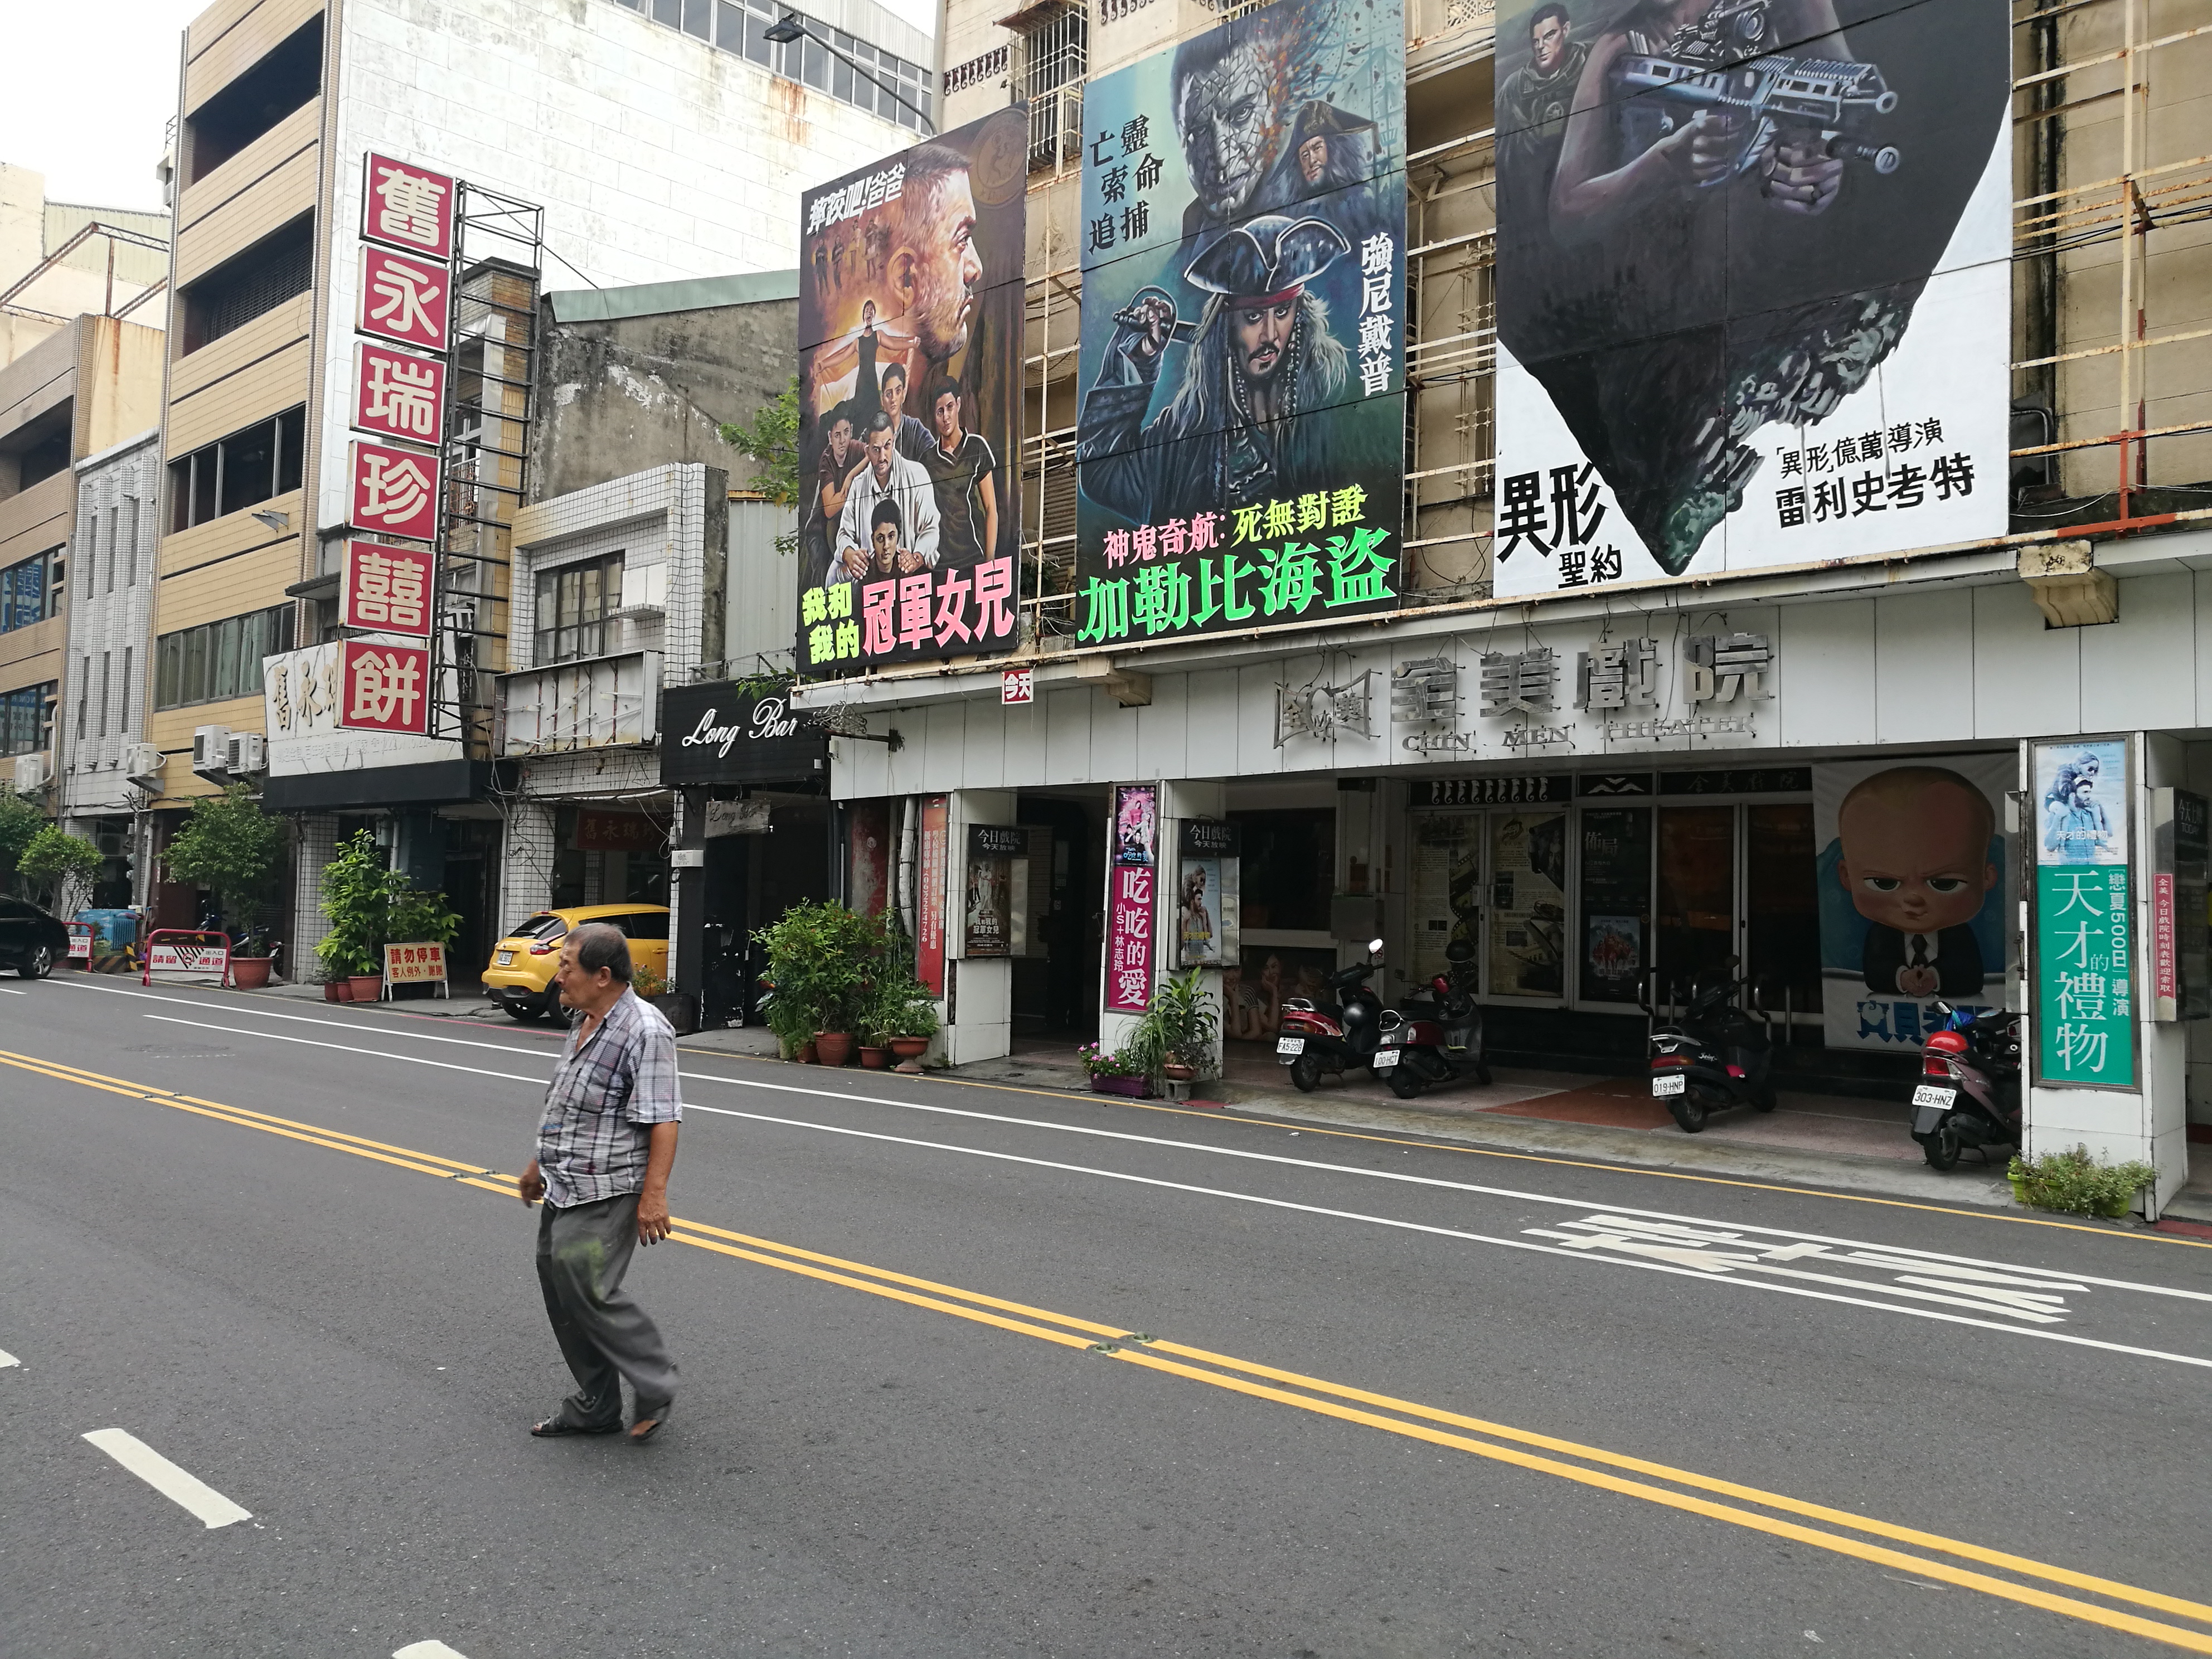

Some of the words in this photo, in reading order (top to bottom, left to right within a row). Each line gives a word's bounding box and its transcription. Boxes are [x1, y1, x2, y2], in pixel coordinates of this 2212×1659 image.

[1089, 114, 1151, 168] 亡靈
[1100, 152, 1165, 206] 索命
[1088, 200, 1149, 254] 追捕
[1358, 231, 1394, 396] 強尼戴普
[350, 167, 445, 726] 舊永瑞珍囍餅
[1230, 483, 1368, 548] 死無對證
[1496, 461, 1609, 564] 異形
[1775, 451, 1975, 530] 雷利史考特
[1077, 526, 1397, 643] 加勒比海盜
[1558, 544, 1622, 589] 聖約
[802, 582, 852, 626] 我和
[862, 555, 1015, 657] 冠軍女兒
[809, 619, 859, 664] 我的
[273, 658, 336, 731] 舊永
[1005, 675, 1030, 700] 今天
[1391, 632, 1768, 723] 全美戲院
[682, 708, 740, 758] Long
[749, 697, 798, 739] Bar
[1503, 725, 1572, 746] MEN
[1595, 715, 1758, 740] THEATER
[1687, 770, 1799, 793] 全美戲院
[710, 803, 736, 828] Long
[978, 828, 1021, 845] 今日戲院
[1190, 824, 1232, 841] 今日戲院
[982, 843, 1016, 852] 今天放映
[1194, 840, 1227, 849] 今天放映
[2158, 877, 2170, 895] 全美
[199, 957, 223, 966] 通道
[390, 947, 441, 965] 請勿停車
[1113, 903, 1126, 973] 小S+林志玲
[1117, 867, 1152, 1007] 吃吃的愛
[2051, 870, 2109, 1073] 天才的禮物
